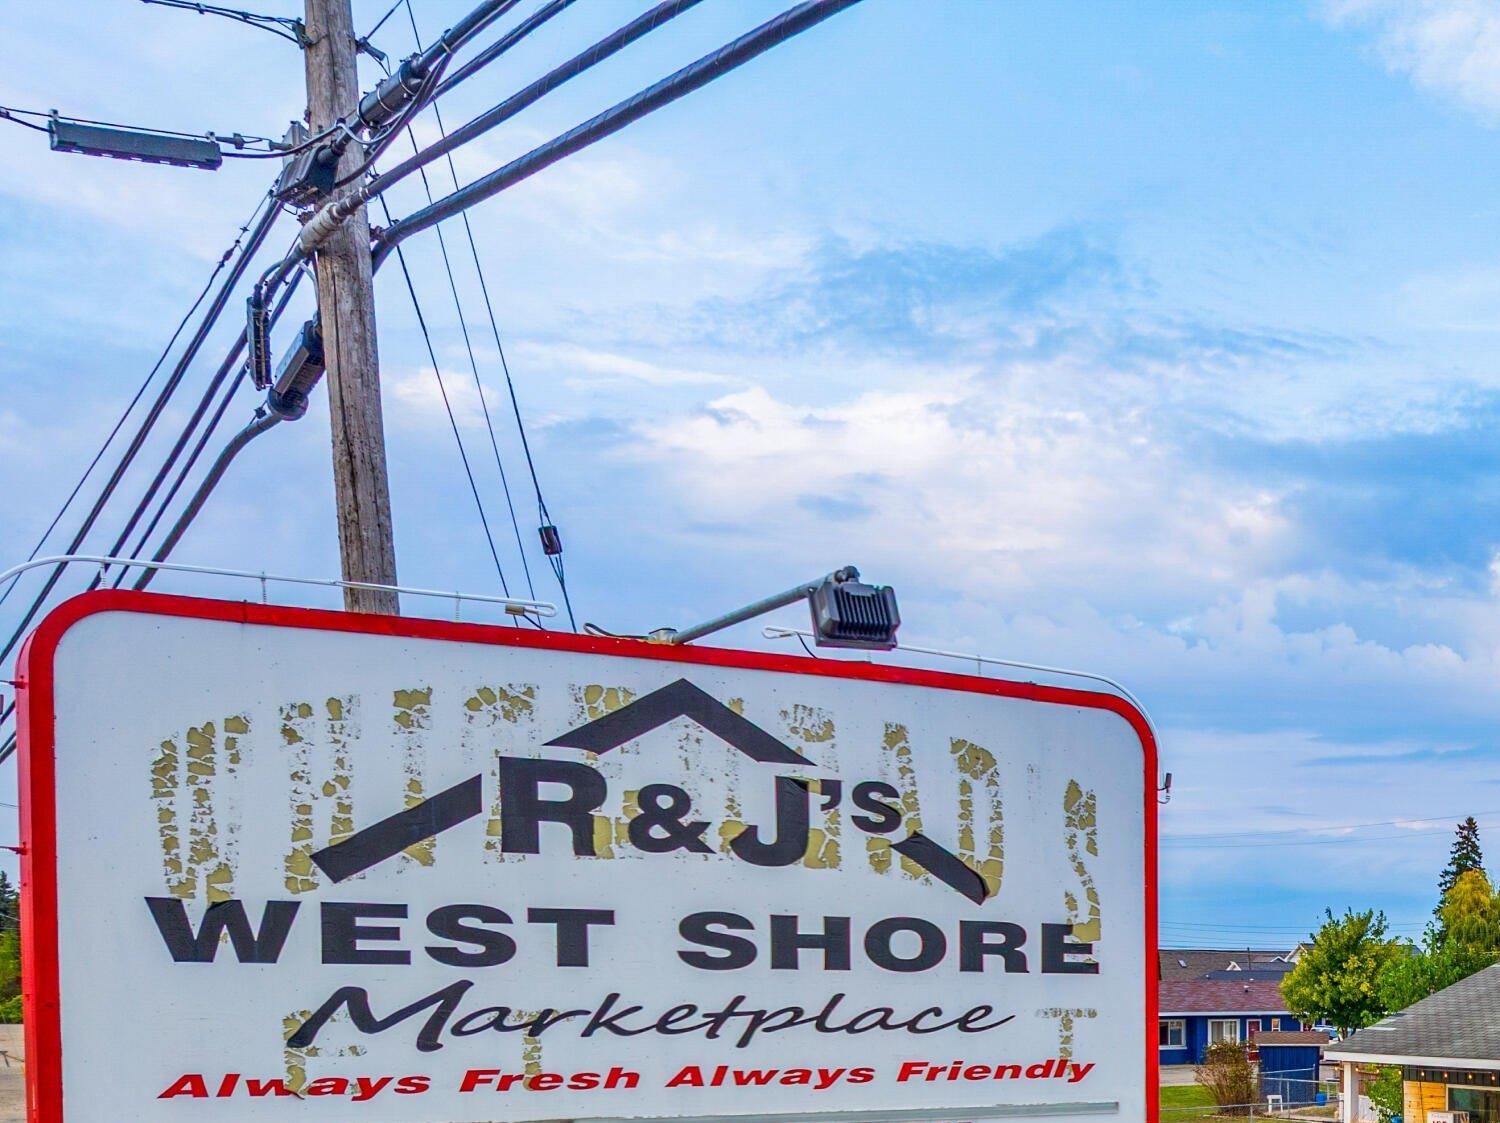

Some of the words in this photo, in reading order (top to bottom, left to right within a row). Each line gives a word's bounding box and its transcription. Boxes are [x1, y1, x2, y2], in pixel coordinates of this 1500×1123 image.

[144, 896, 615, 968] WEST
[677, 911, 1100, 975] SHORE
[286, 979, 1016, 1052] Marketplace
[157, 1072, 432, 1101] Always
[459, 1066, 641, 1093] Fresh
[666, 1065, 876, 1090] Always
[896, 1059, 1095, 1083] Friendly
